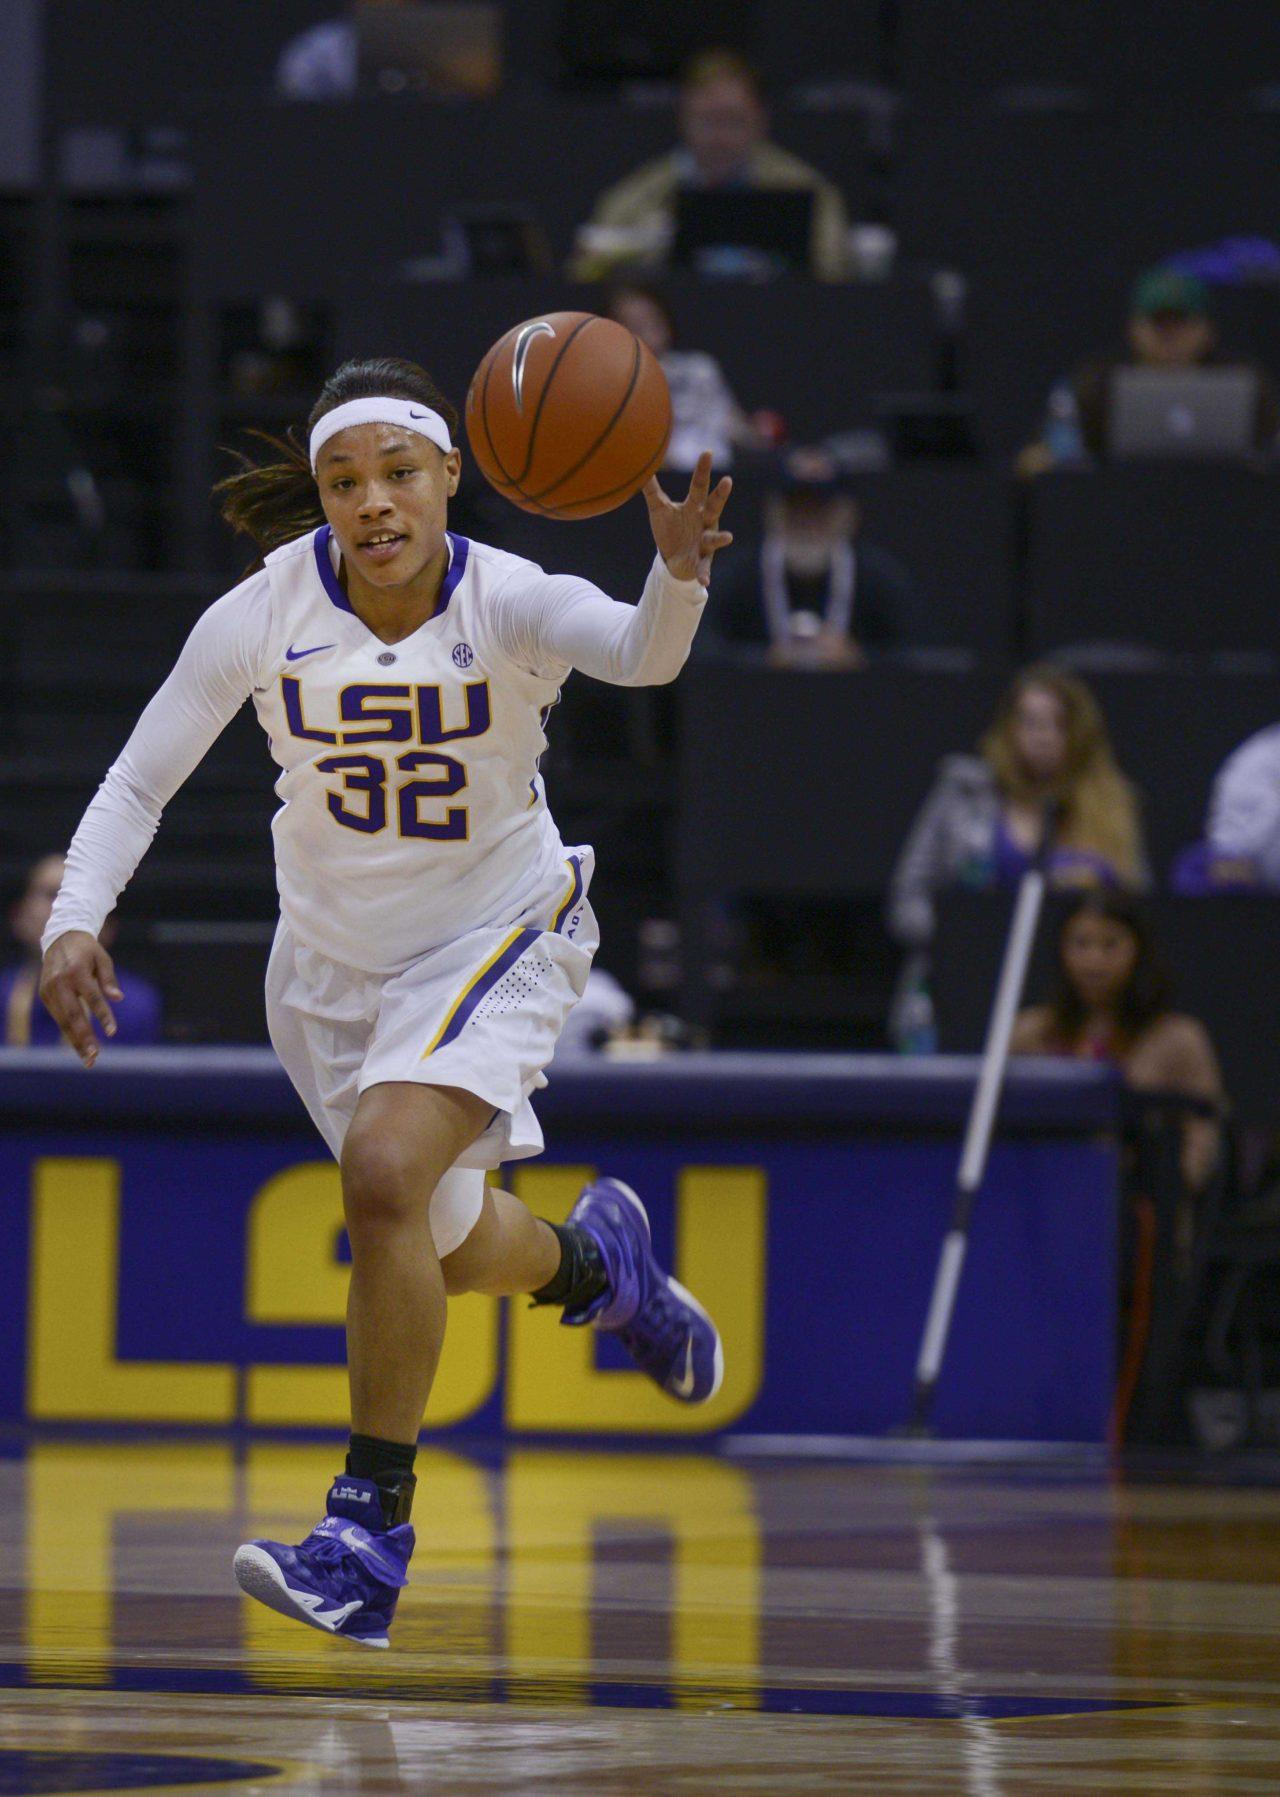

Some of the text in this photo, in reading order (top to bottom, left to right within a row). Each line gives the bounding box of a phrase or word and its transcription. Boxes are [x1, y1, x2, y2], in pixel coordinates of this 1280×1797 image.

[453, 644, 472, 667] SEC
[280, 674, 491, 747] LSU
[313, 749, 469, 841] 32
[26, 1157, 768, 1433] LSU
